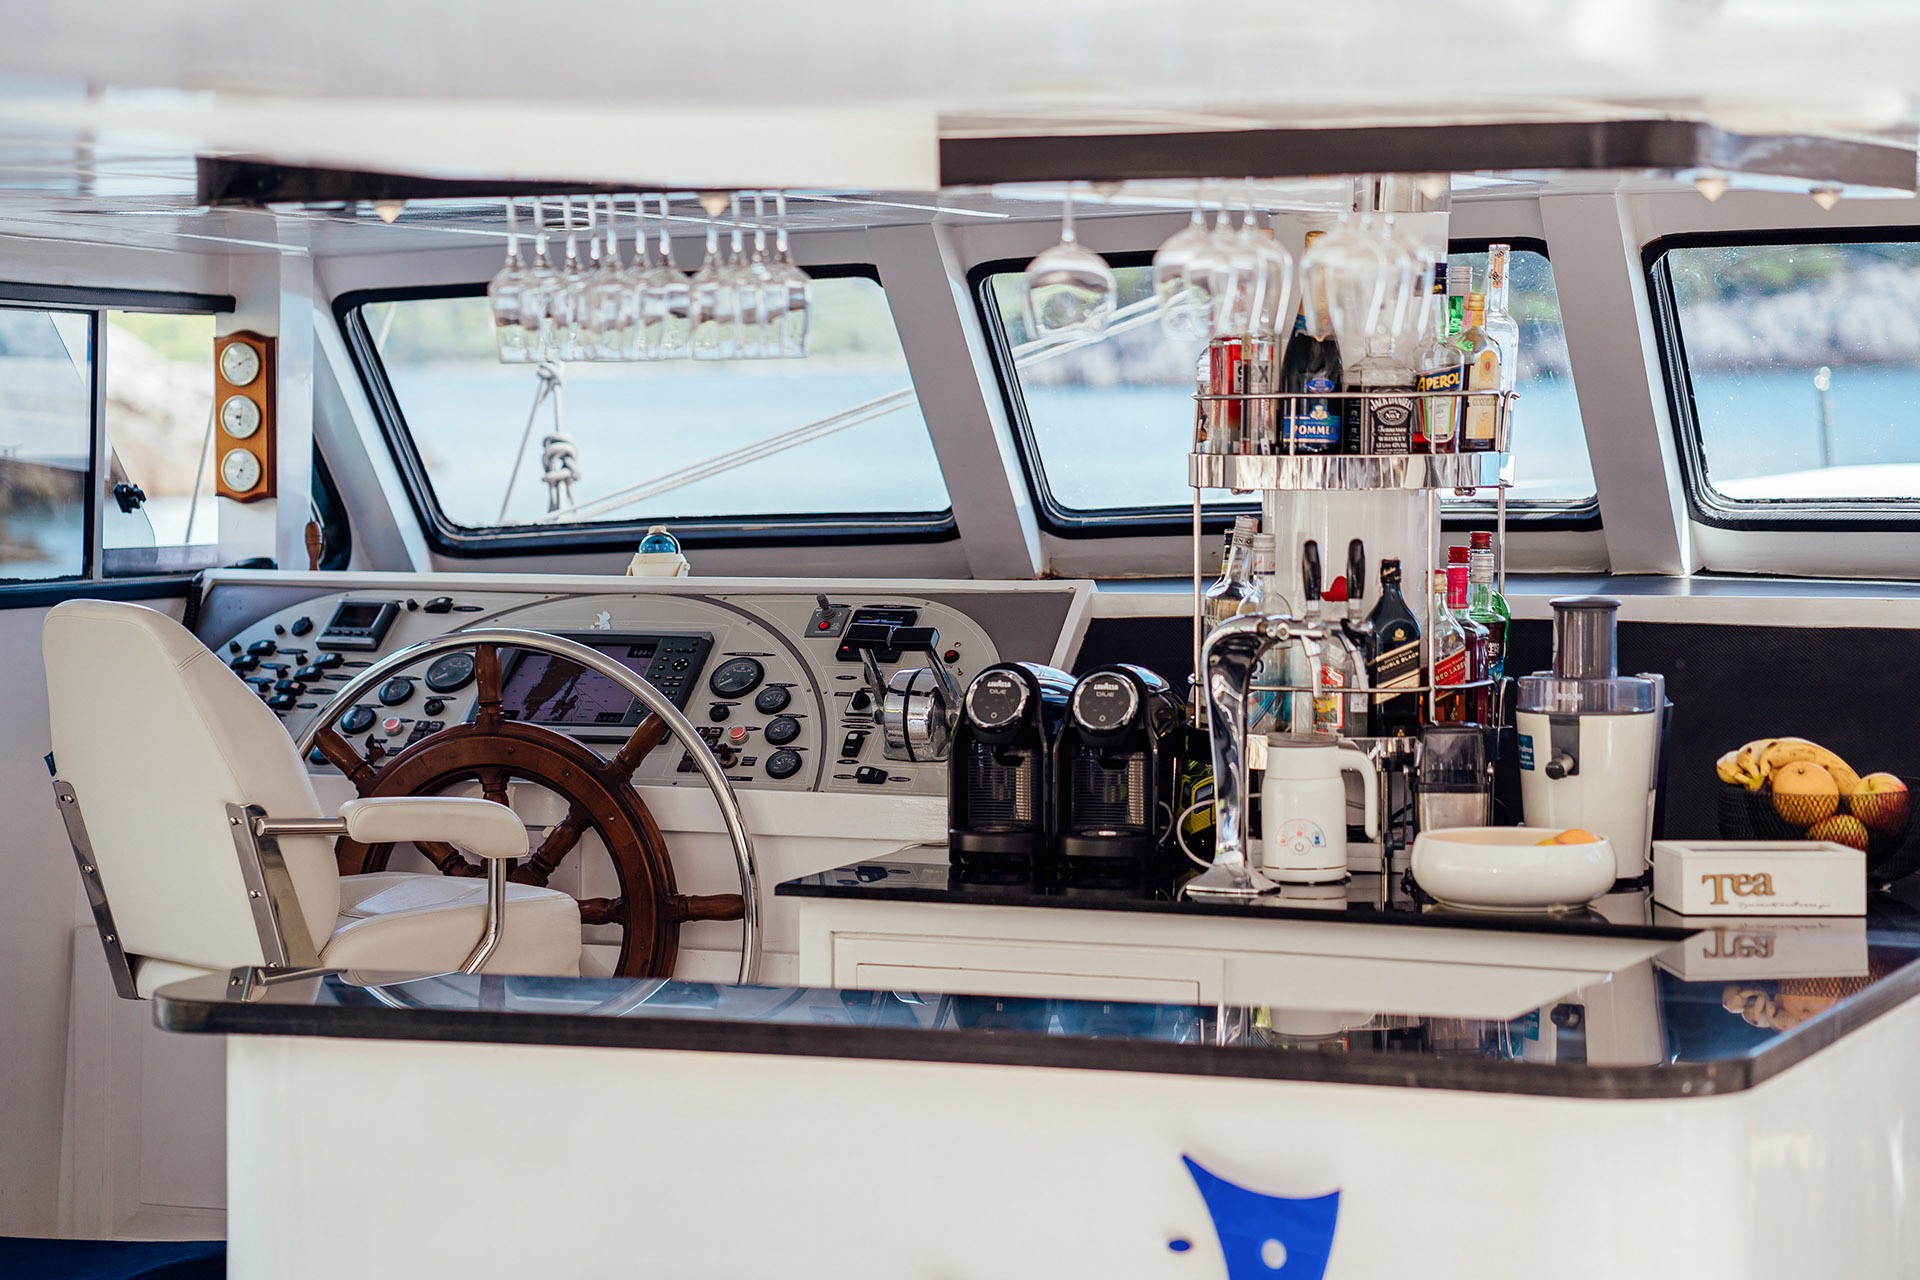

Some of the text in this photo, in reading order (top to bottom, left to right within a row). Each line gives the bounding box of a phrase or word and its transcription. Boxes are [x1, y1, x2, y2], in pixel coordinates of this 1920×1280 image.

[1417, 372, 1460, 392] APEROL
[1377, 651, 1419, 672] DOUBLE BLACK
[1435, 671, 1449, 682] RED
[1702, 872, 1776, 905] Tea
